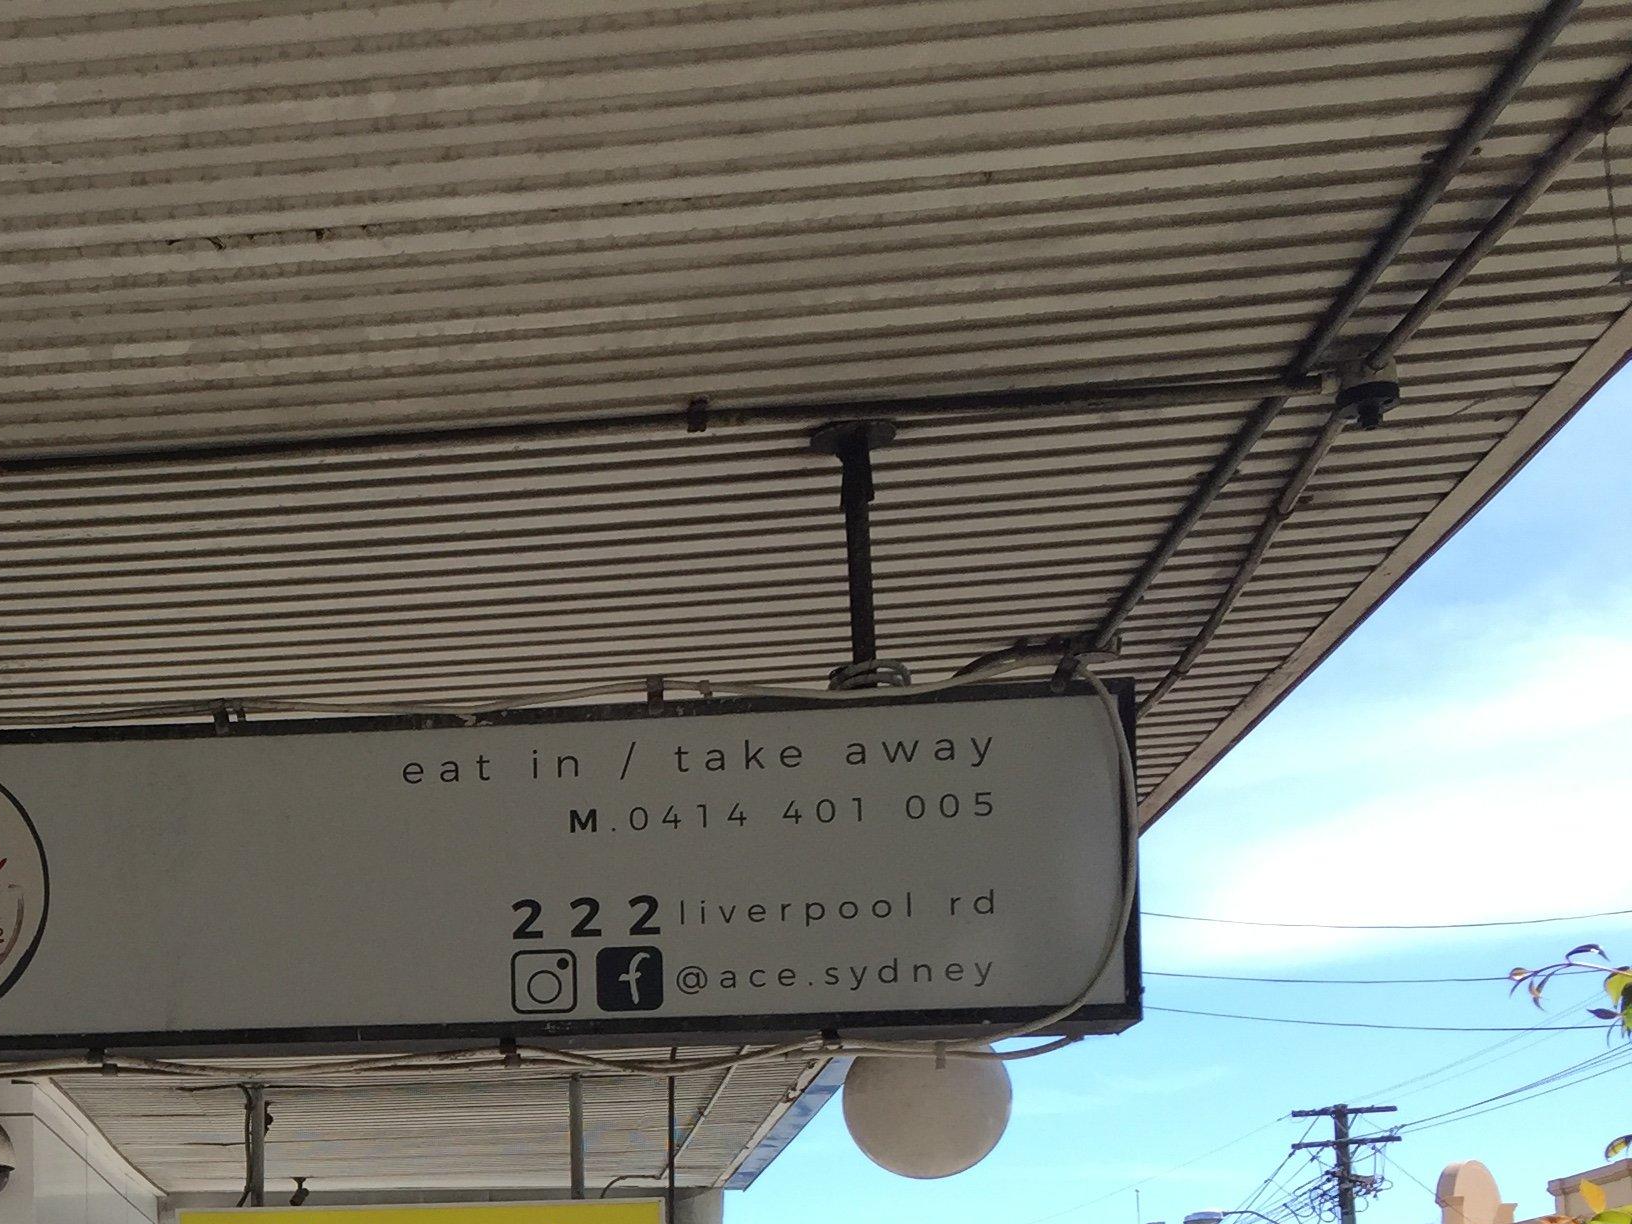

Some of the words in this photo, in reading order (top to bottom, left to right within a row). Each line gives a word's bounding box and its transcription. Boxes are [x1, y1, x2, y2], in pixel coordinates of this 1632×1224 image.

[402, 753, 492, 785] eat
[532, 749, 581, 780] in
[618, 740, 638, 781] /
[675, 739, 804, 774] take
[845, 734, 994, 768] away
[569, 803, 748, 834] M.0414
[782, 797, 865, 825] 401
[905, 791, 994, 821] 005
[679, 891, 913, 927] liverpool
[949, 888, 995, 918] rd
[676, 958, 994, 995] @ace.sydney
